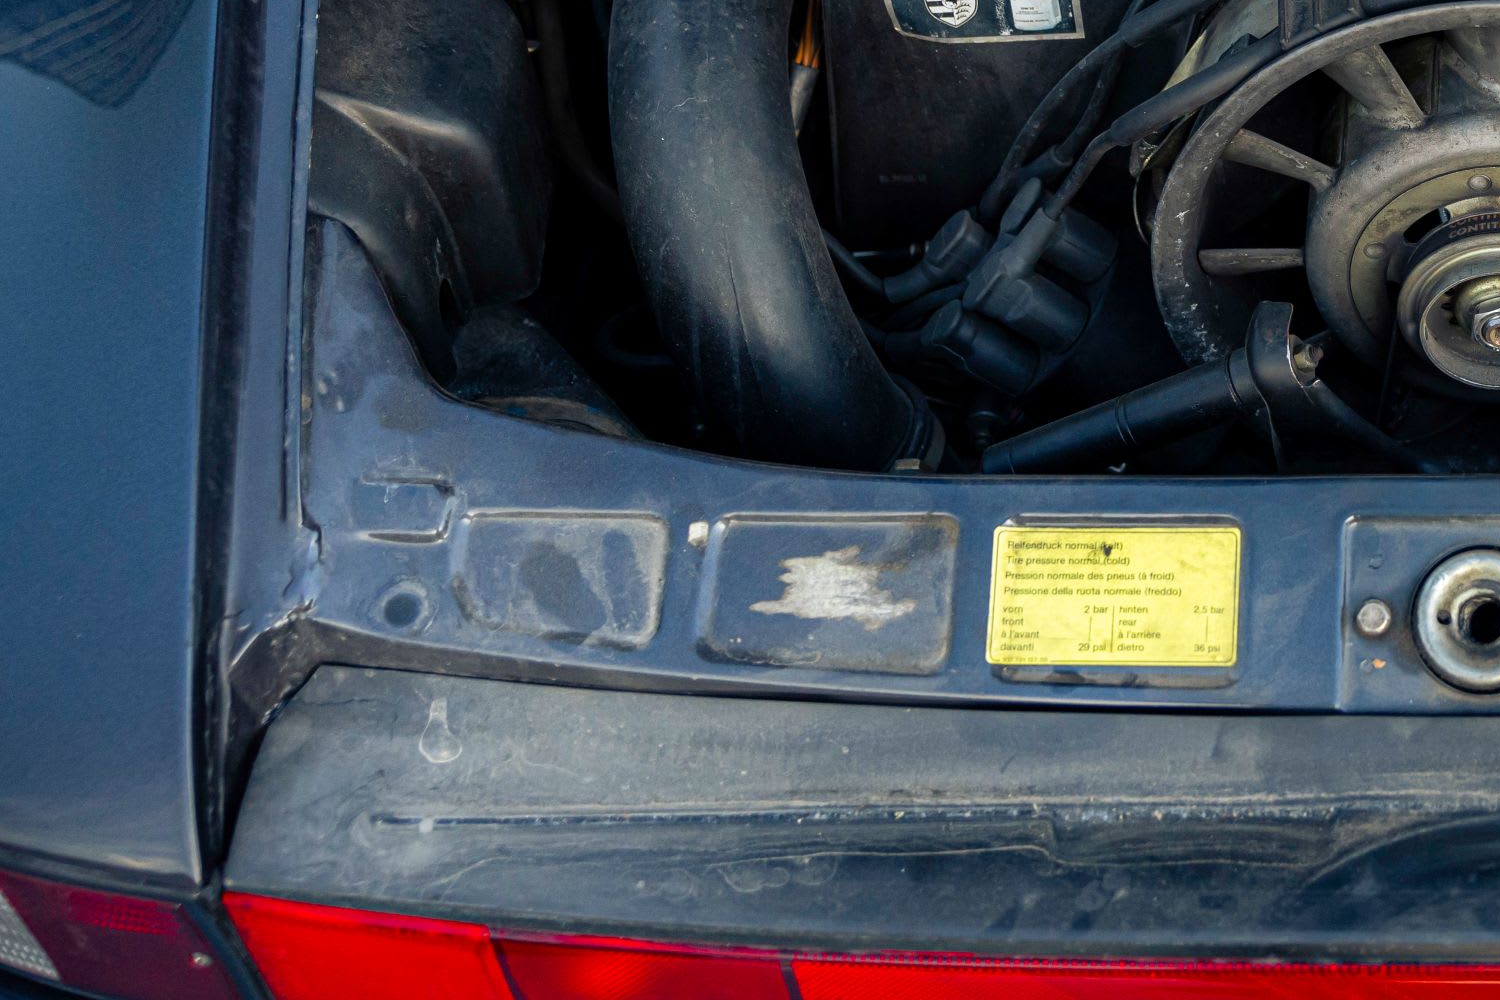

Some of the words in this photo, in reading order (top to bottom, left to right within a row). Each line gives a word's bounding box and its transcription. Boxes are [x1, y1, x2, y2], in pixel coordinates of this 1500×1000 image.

[1006, 556, 1023, 565] Tire
[1025, 557, 1066, 567] pressure
[1005, 571, 1044, 580] Pression
[1047, 571, 1085, 580] normale
[1087, 571, 1104, 580] des
[1106, 573, 1135, 582] pneus
[1150, 571, 1175, 581] froid)
[1004, 586, 1049, 595] Pressione
[1051, 586, 1073, 595] della
[1076, 587, 1100, 596] ruota
[1103, 587, 1142, 596] normale
[1144, 587, 1182, 597] (freddo)
[1084, 605, 1090, 614] 2
[1093, 605, 1109, 614] bar
[1118, 605, 1149, 614] hinten
[1001, 617, 1024, 626] front
[1118, 618, 1137, 627] rear
[1078, 642, 1090, 652] 29
[1117, 642, 1145, 652] dietro
